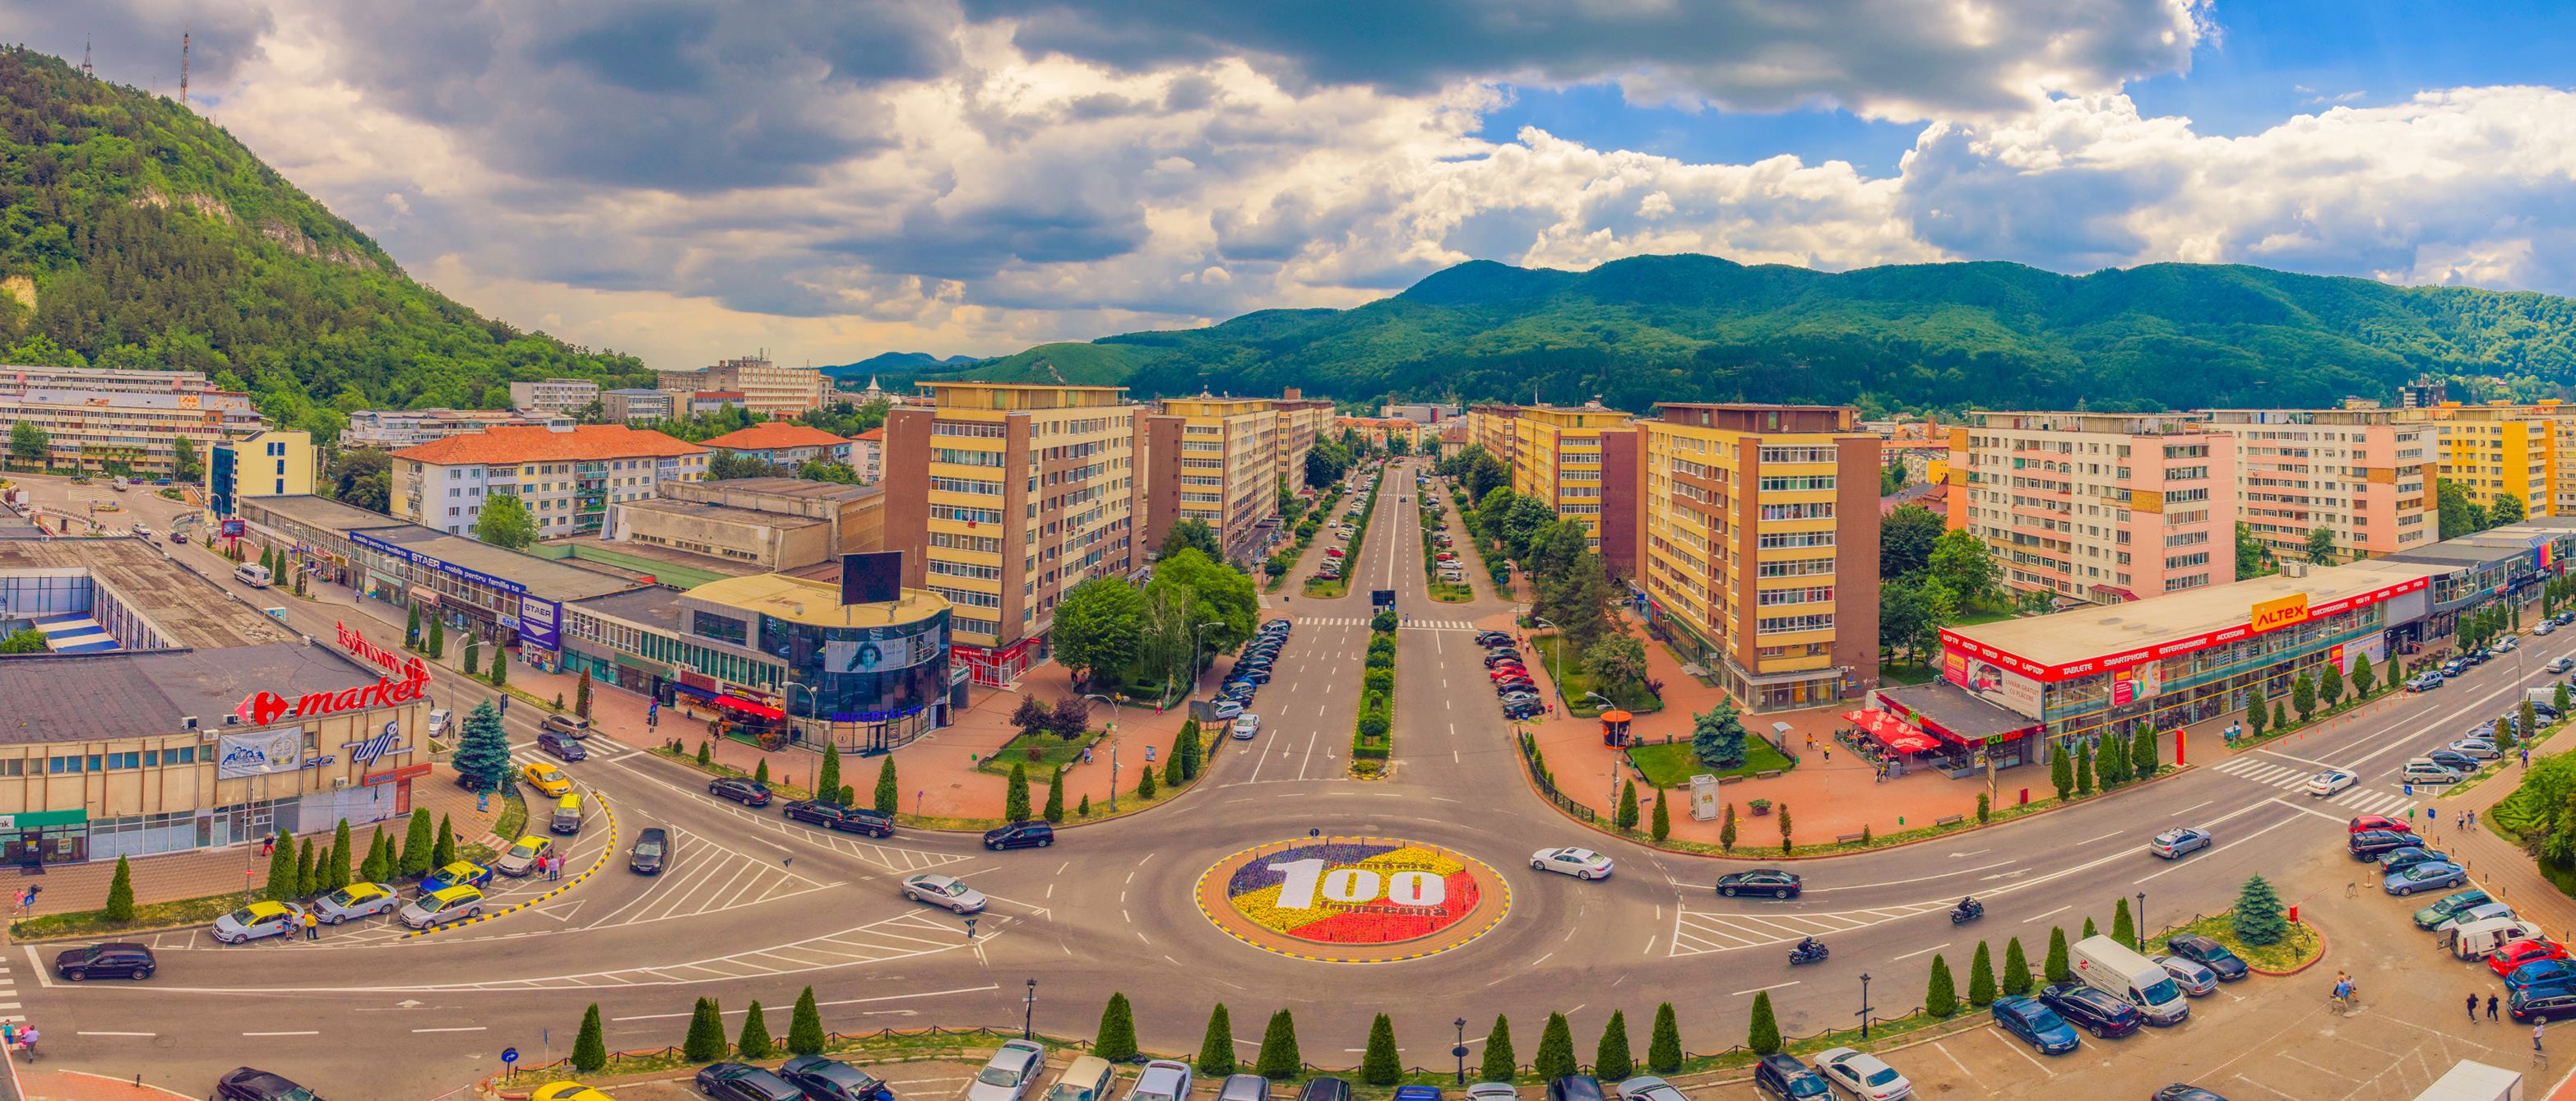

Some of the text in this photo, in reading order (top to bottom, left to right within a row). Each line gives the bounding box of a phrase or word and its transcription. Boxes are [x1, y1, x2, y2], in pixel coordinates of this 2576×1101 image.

[368, 540, 385, 550] pentru
[411, 553, 441, 569] STAER
[444, 564, 520, 593] mobila pentru familia ta
[2377, 590, 2391, 599] AUDIO
[524, 604, 551, 618] STAER
[2257, 604, 2305, 627] ALTEX
[1943, 634, 2045, 675] LED TV AUDIO VIDEO FOTO LAPTOP
[2062, 663, 2093, 675] TABLETE
[2103, 651, 2149, 668] SMARTPHONE
[2159, 637, 2208, 655] ENTERTAINMENT
[295, 670, 430, 718] market
[832, 709, 905, 724] IMPERIAL
[1267, 858, 1446, 909] 100
